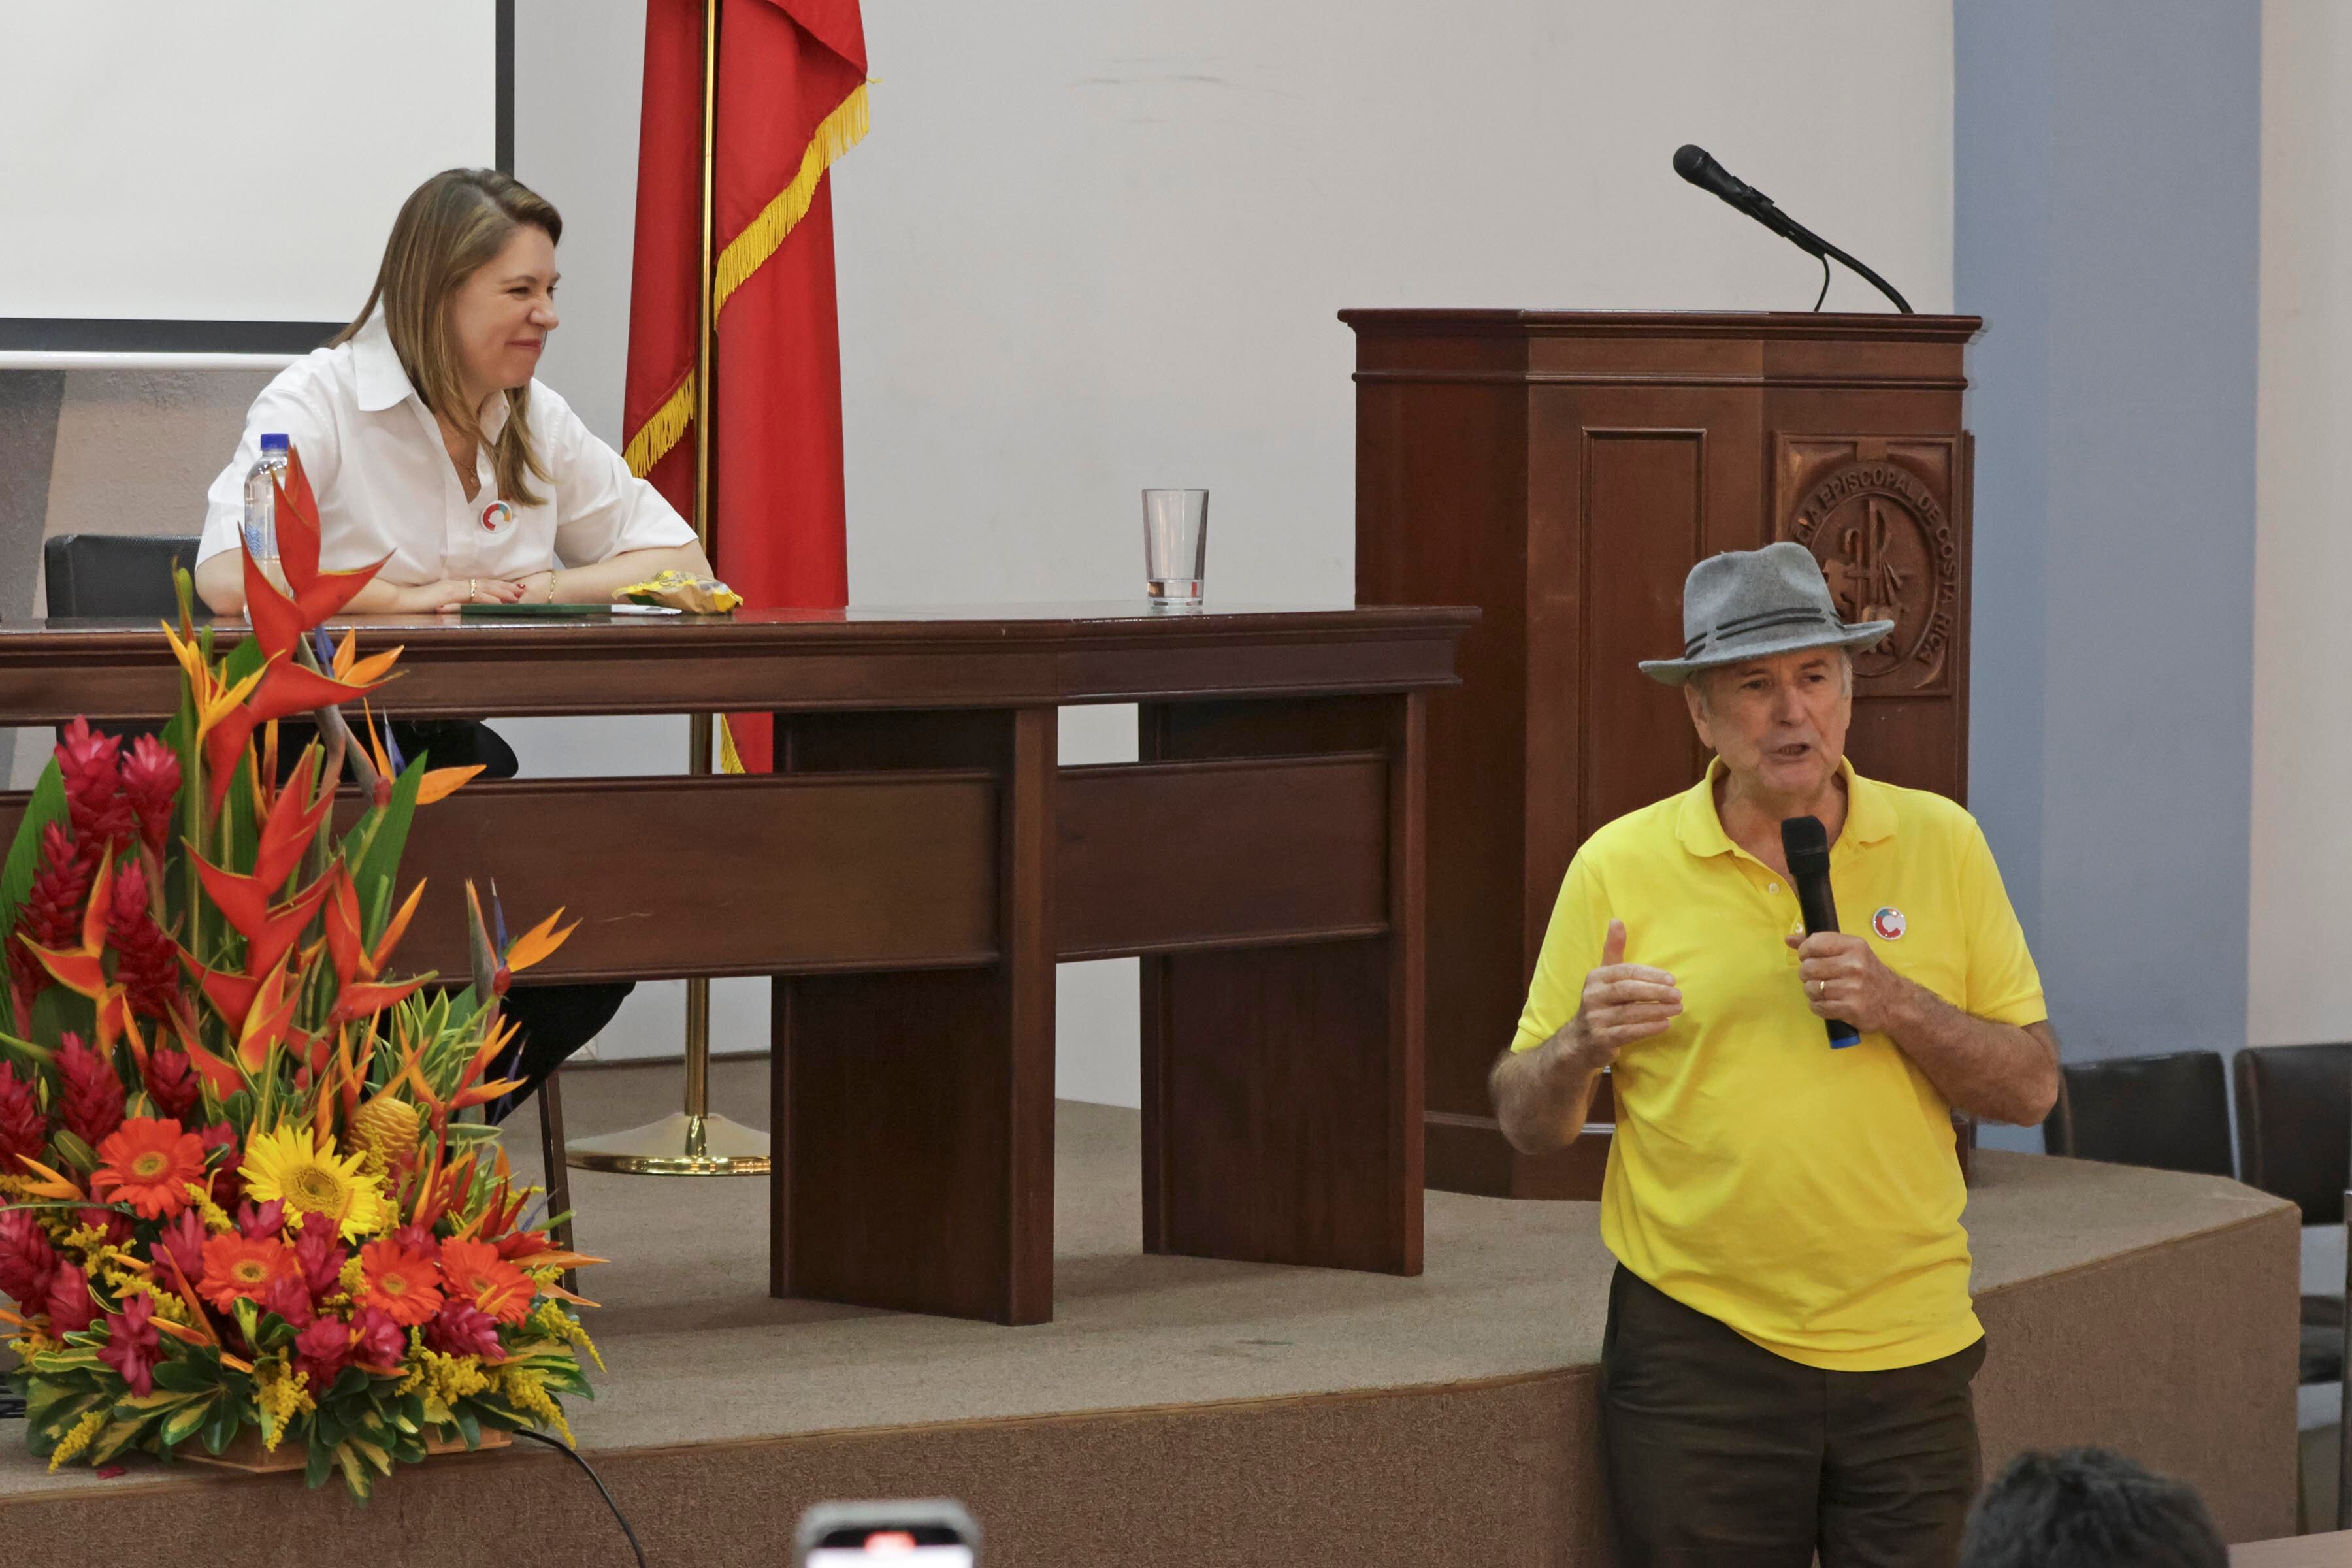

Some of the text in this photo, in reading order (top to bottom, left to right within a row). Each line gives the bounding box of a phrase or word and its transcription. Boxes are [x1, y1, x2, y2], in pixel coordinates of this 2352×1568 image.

[1819, 467, 1957, 664] EPISCOPAL DE COSTA RICA
